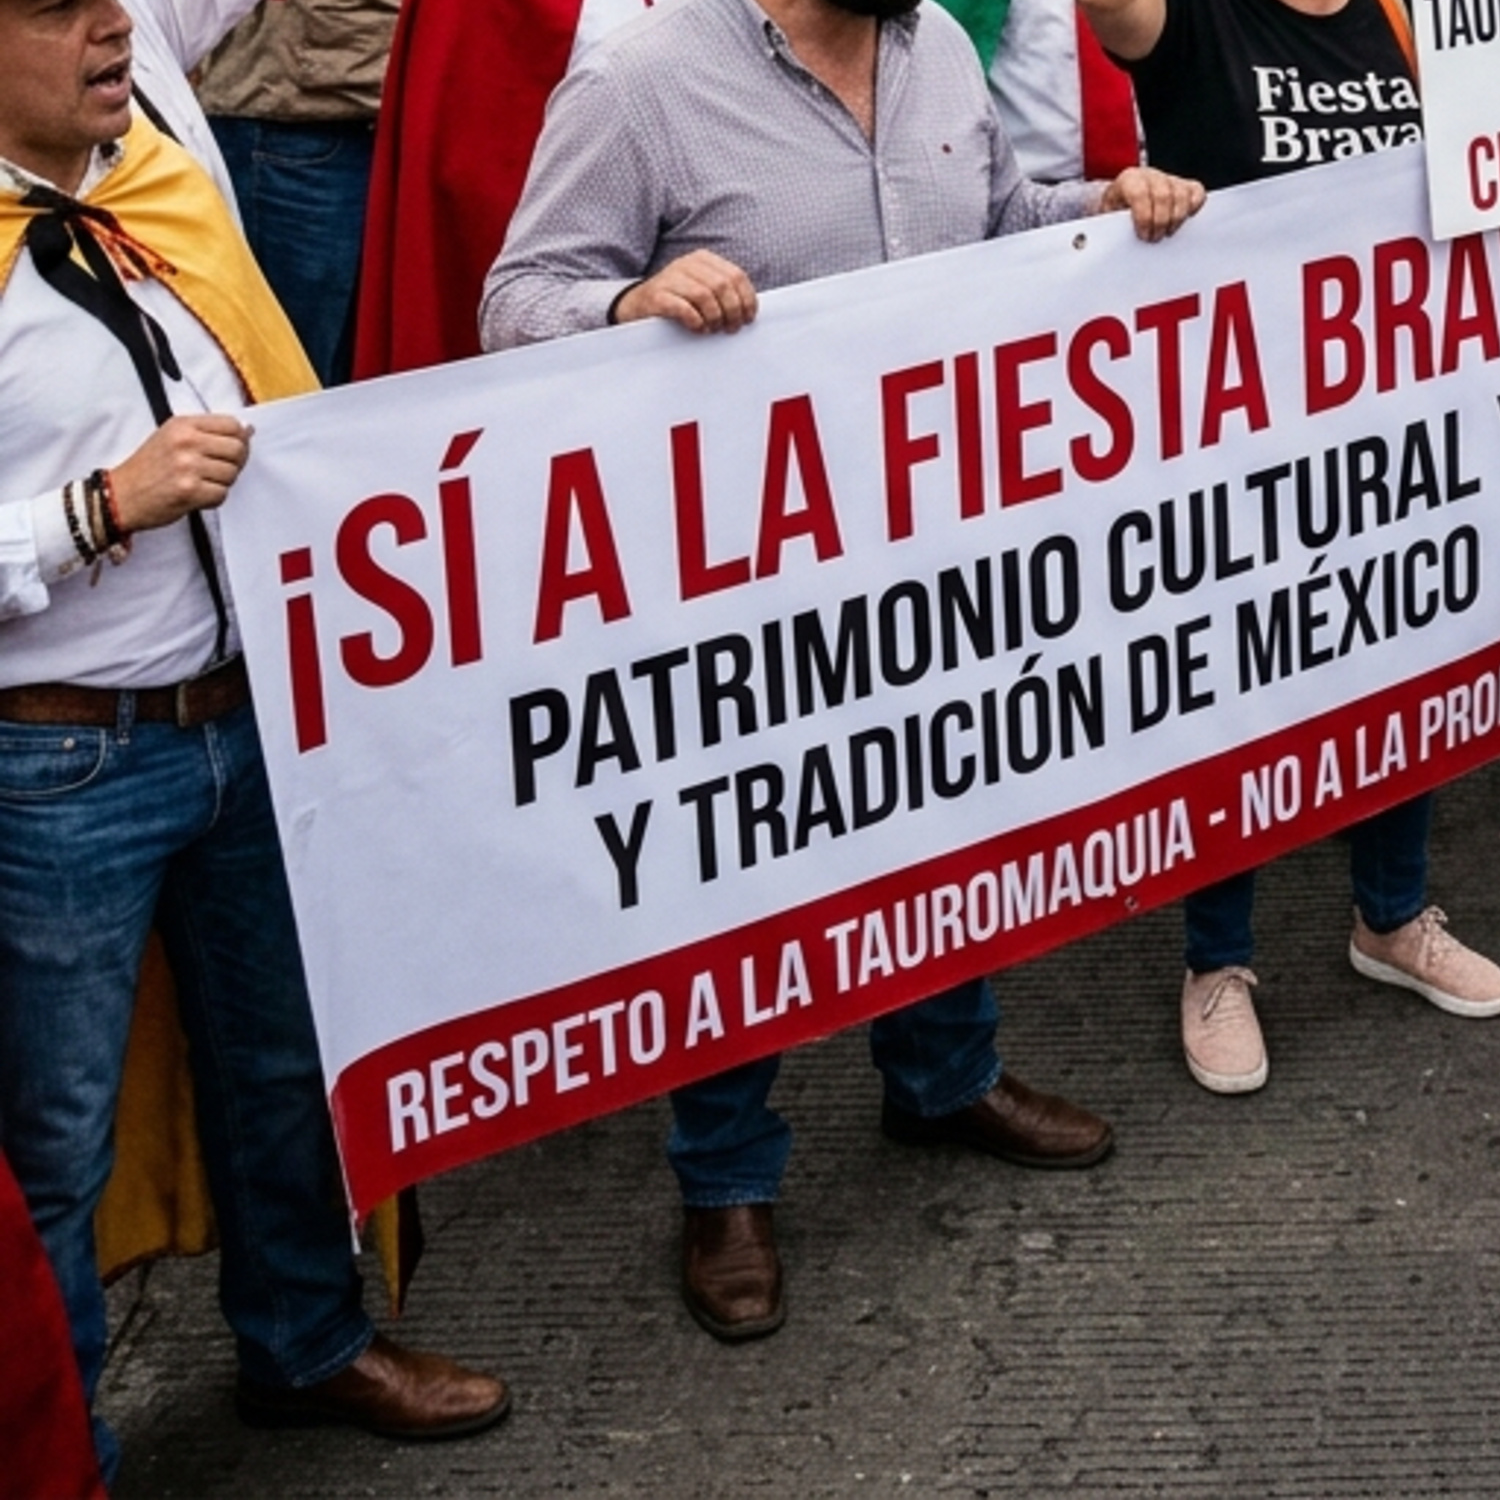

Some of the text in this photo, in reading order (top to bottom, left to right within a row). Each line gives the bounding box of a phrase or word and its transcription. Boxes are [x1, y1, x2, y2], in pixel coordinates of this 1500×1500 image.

[1252, 65, 1421, 114] Fiesta
[279, 427, 486, 756] ¡SÍ
[532, 447, 633, 645] A
[669, 392, 845, 601] LA
[880, 280, 1271, 543] FIESTA
[508, 534, 1081, 807] PATRIMONIO
[1107, 410, 1481, 614] CULTURAL
[593, 524, 1480, 911] Y TRADICIÓN DE MÉXICO
[386, 989, 667, 1155] RESPETO
[684, 970, 725, 1049] A
[740, 938, 813, 1028] LA
[825, 798, 1196, 995] TAUROMAQUIA
[1239, 754, 1301, 840] NO
[1313, 739, 1344, 810] A
[1355, 711, 1408, 787] LA
